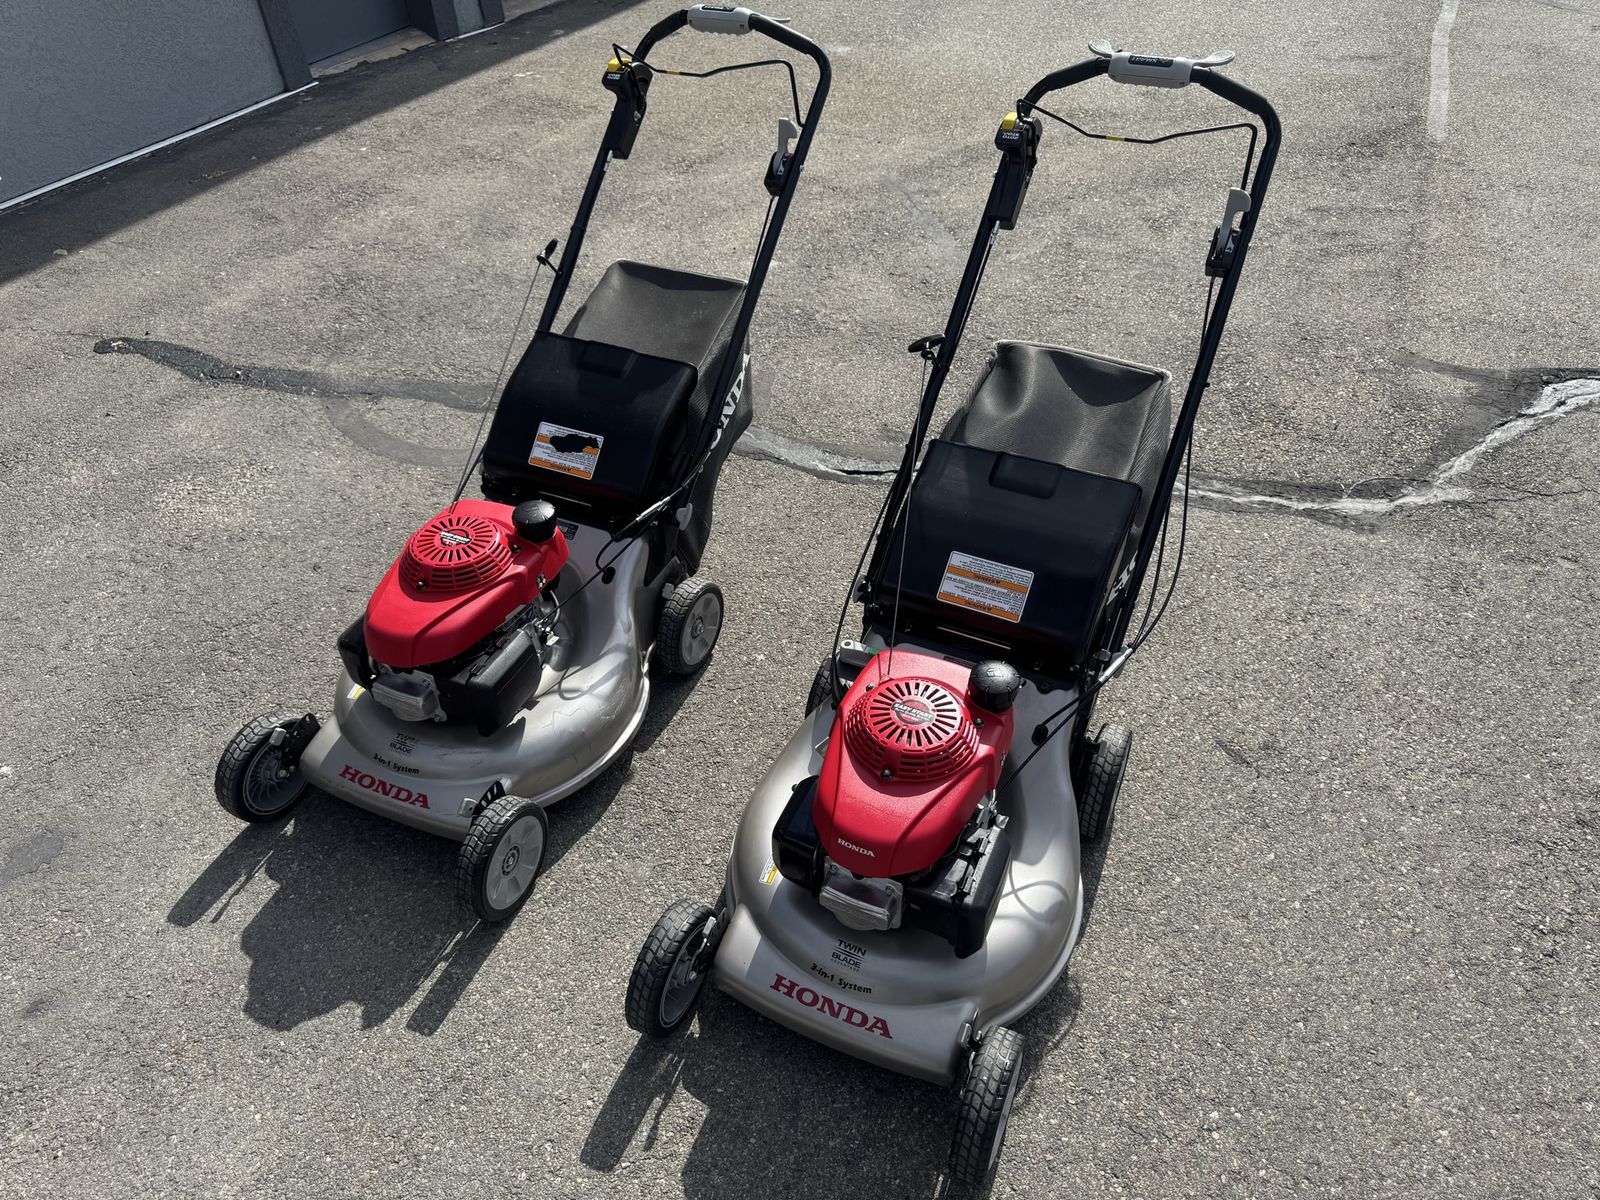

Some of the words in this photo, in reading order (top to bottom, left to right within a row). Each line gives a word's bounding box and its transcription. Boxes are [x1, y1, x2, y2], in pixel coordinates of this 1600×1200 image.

[393, 763, 420, 775] System
[338, 764, 430, 809] HONDA
[837, 838, 876, 857] HONDA
[838, 938, 867, 956] TWIN
[831, 951, 862, 968] BLADE
[810, 963, 835, 982] 3-in-1
[837, 978, 872, 994] System
[769, 973, 893, 1039] HONDA
